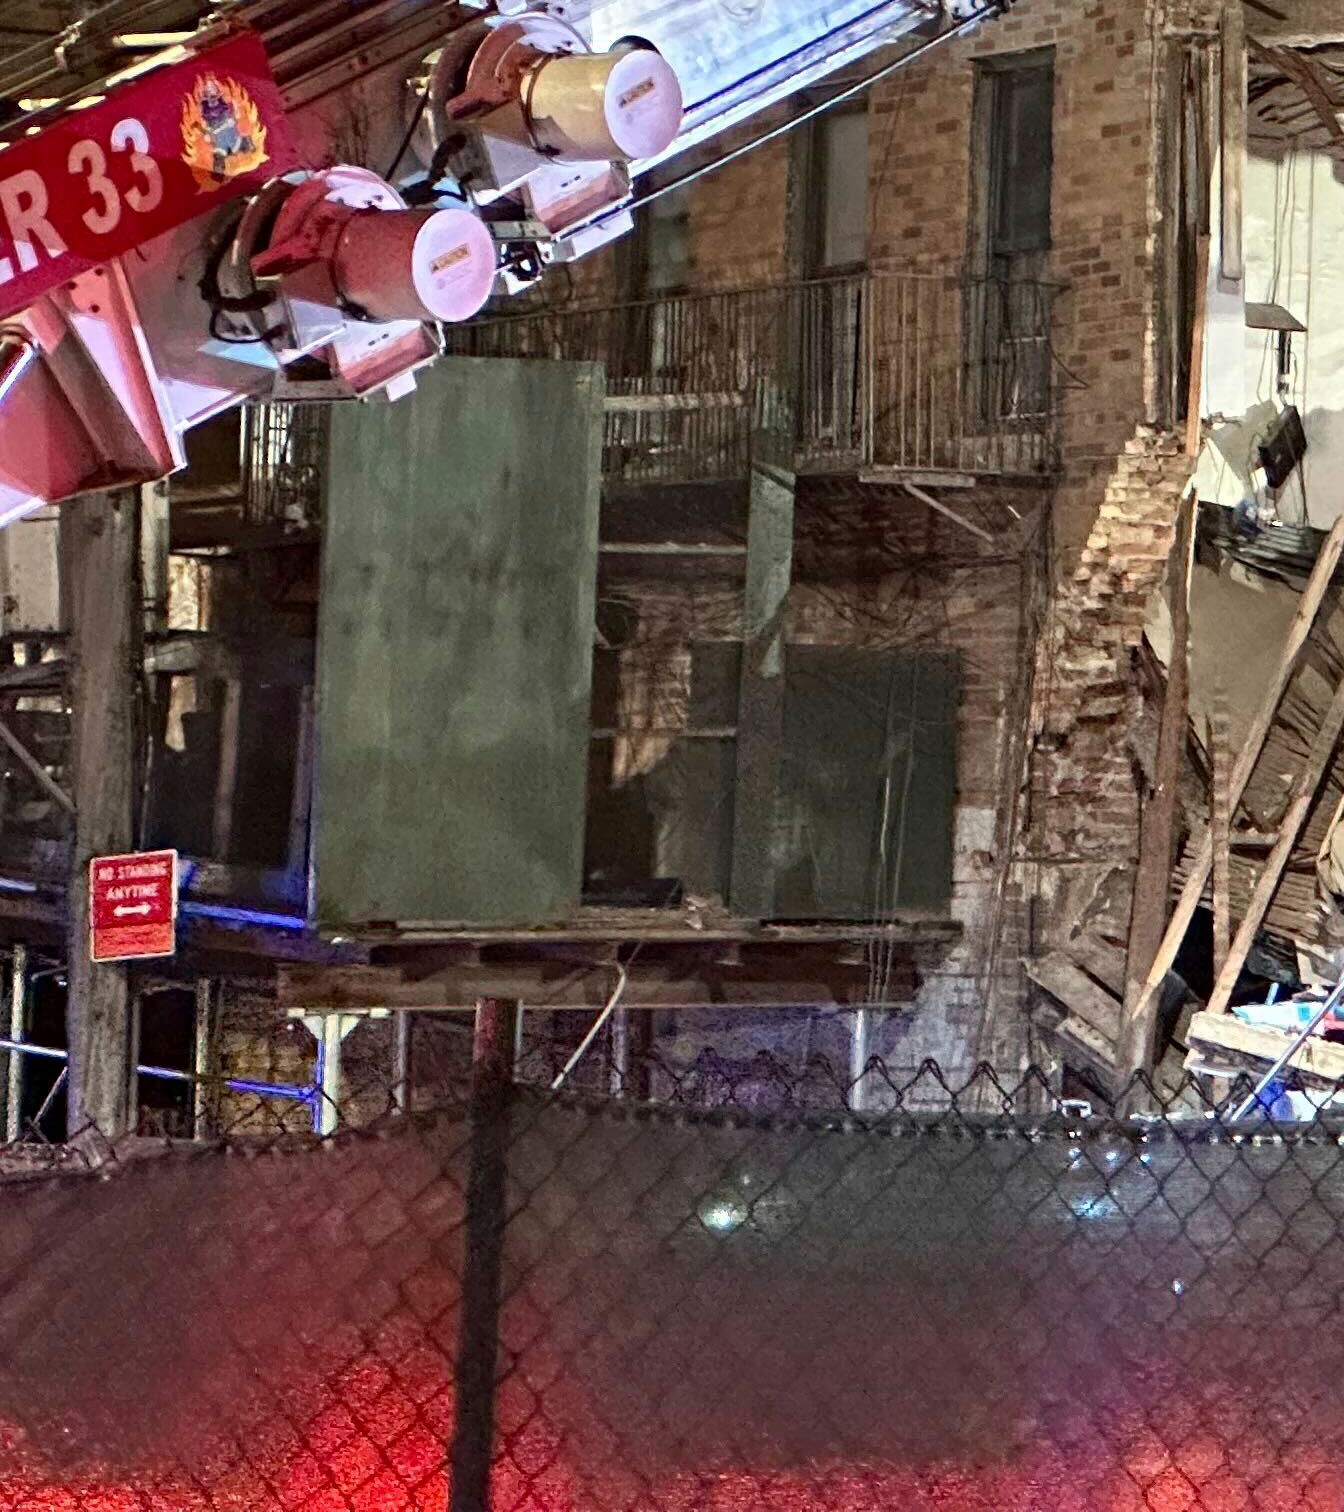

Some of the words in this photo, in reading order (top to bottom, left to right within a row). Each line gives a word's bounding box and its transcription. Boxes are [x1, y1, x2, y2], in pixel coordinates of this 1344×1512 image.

[0, 169, 68, 285] R
[67, 118, 163, 234] 33
[105, 883, 159, 901] ANYTIME
